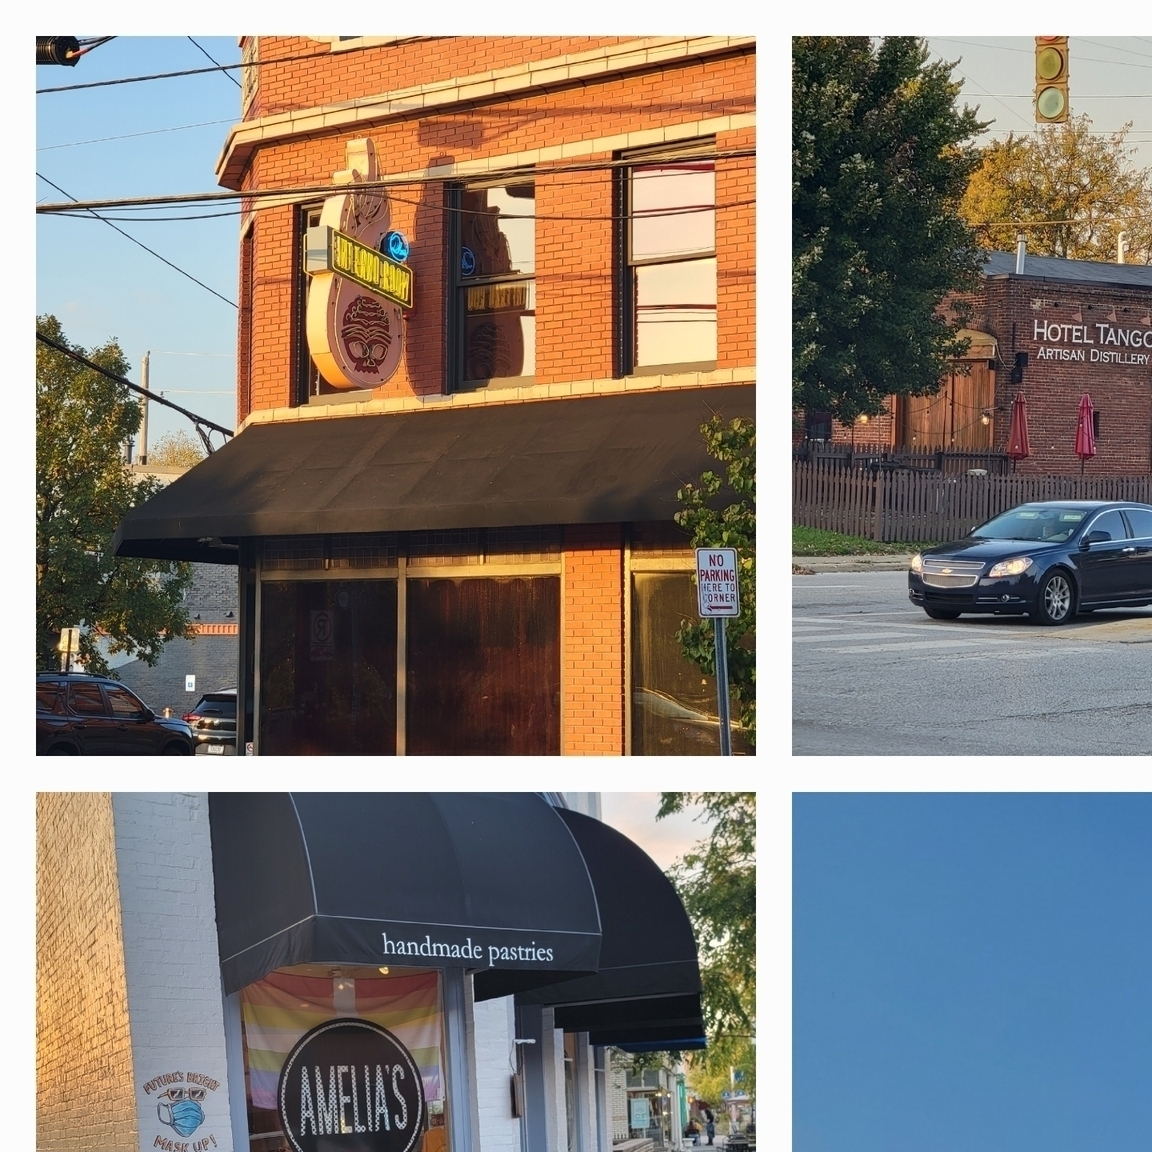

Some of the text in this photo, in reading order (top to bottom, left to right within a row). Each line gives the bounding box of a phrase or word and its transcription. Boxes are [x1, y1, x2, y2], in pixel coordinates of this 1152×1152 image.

[1033, 319, 1094, 344] HOTEL
[1037, 347, 1150, 365] ARTISAN DISTILLERY
[709, 554, 724, 567] NO
[700, 569, 735, 582] PARKING
[701, 583, 736, 592] HERE TO
[703, 594, 736, 603] CORNER
[381, 932, 554, 967] handmade pastries
[143, 1070, 220, 1095] FUTURE'S BRIGHT
[300, 1063, 408, 1137] AMELIA'S
